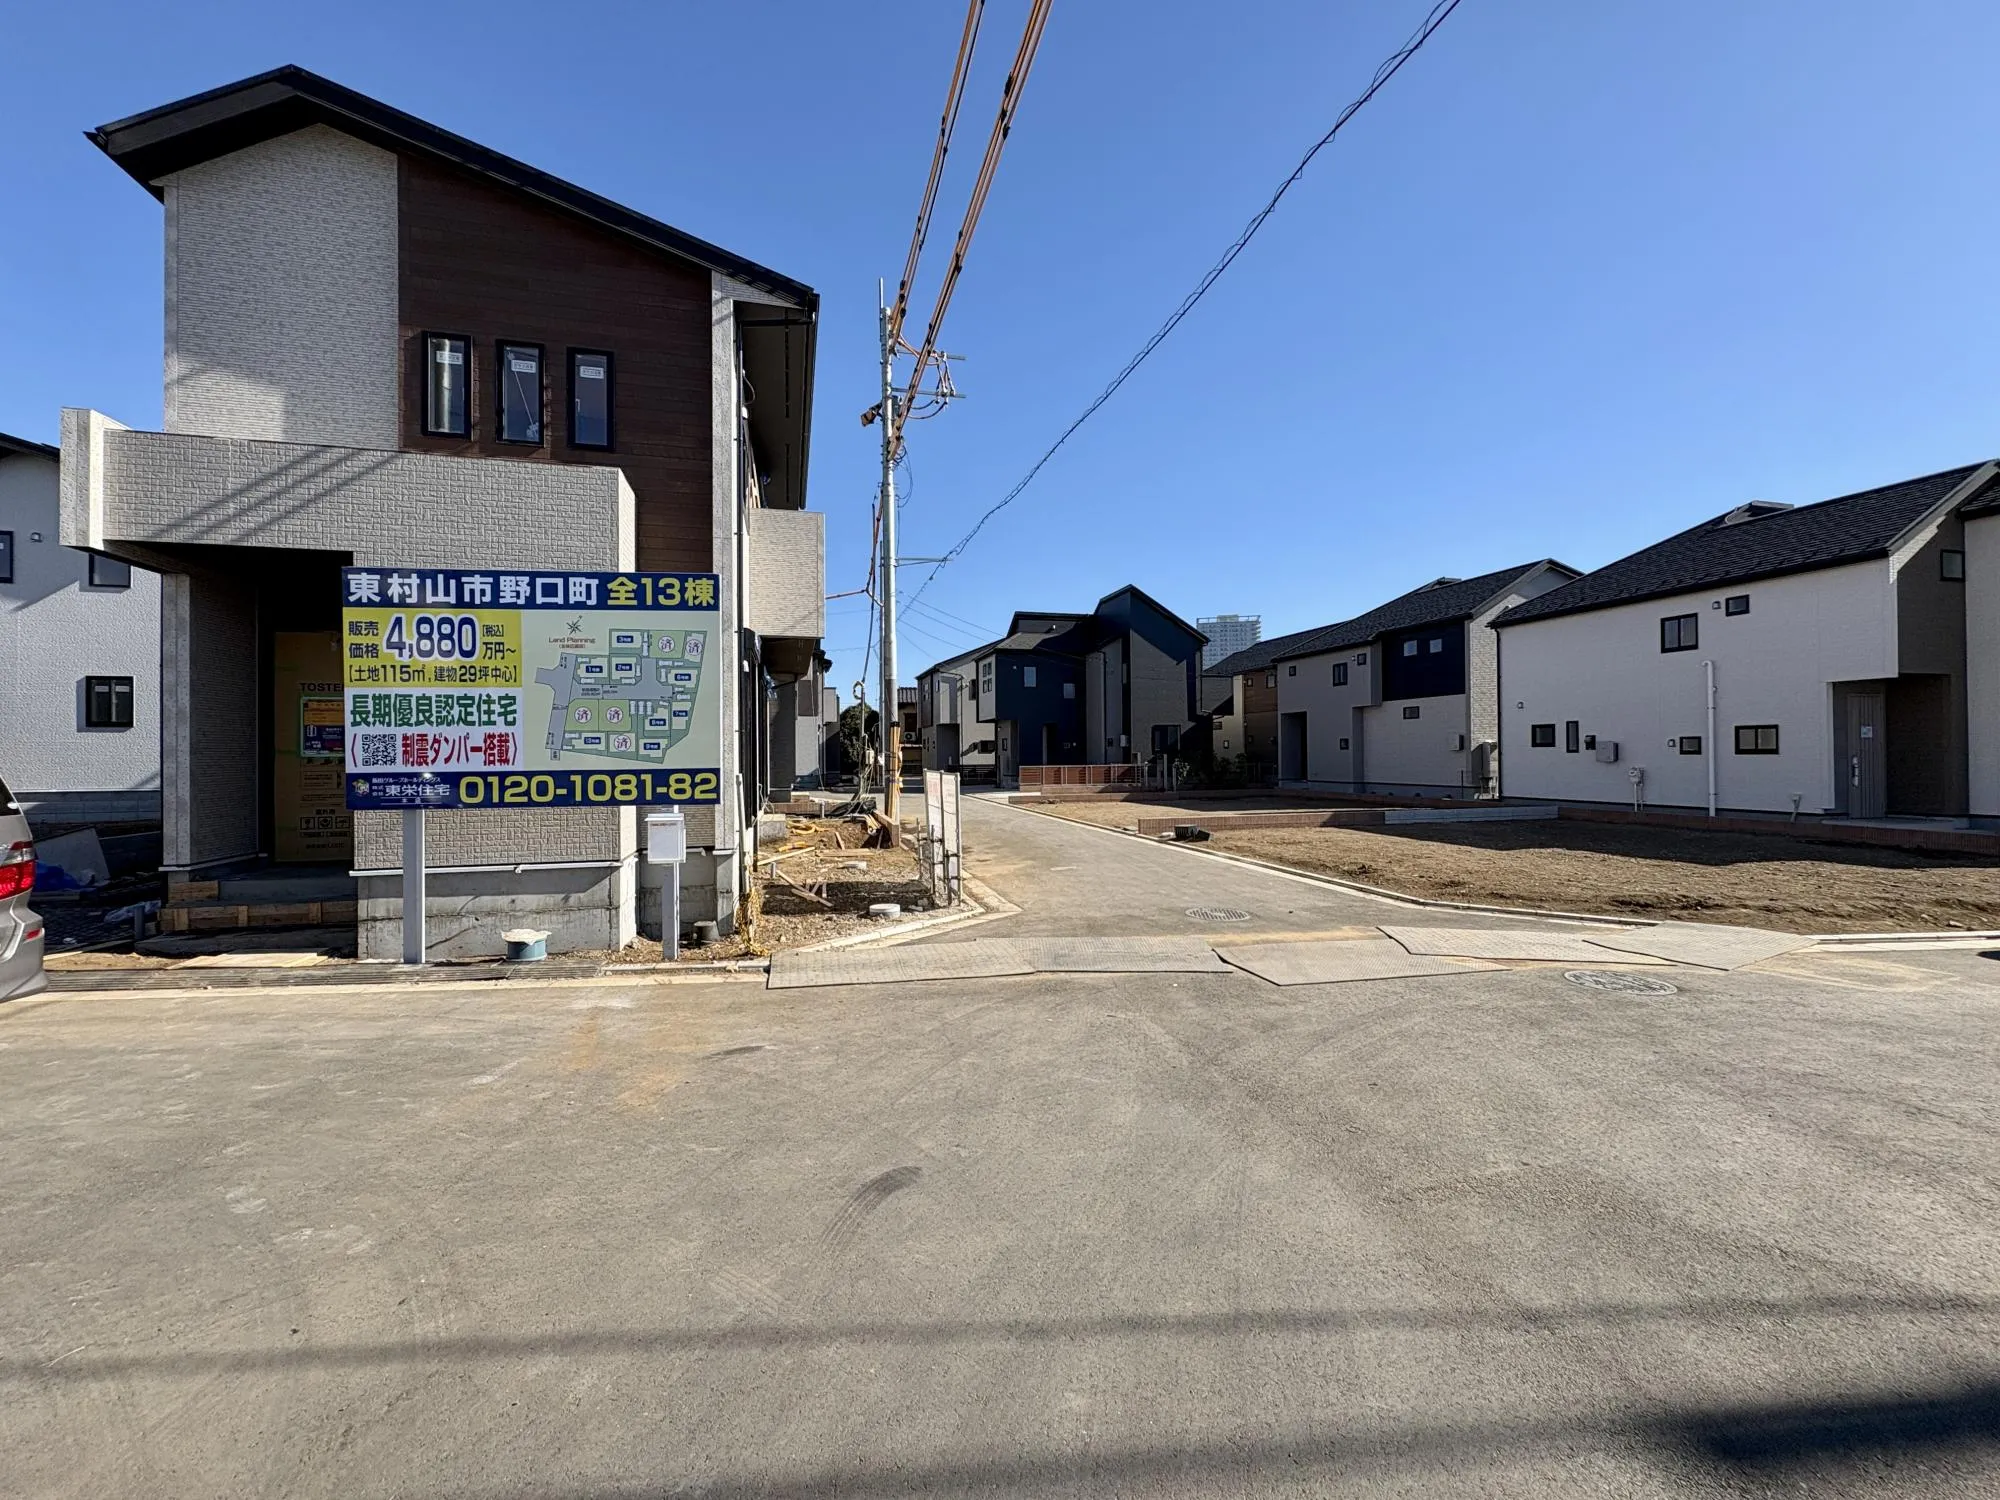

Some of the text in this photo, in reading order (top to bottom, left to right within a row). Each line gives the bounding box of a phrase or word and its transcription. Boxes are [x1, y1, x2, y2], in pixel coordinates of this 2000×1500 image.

[347, 572, 715, 607] 東村山市野口町 全13棟
[348, 620, 379, 637] 販売
[384, 615, 478, 660] 4,880
[348, 642, 379, 659] 価格
[299, 682, 344, 692] TOSTE
[350, 693, 517, 728] 長期優良認定住宅
[384, 784, 451, 797] 東栄住宅
[459, 773, 718, 803] 0120-1081-82
